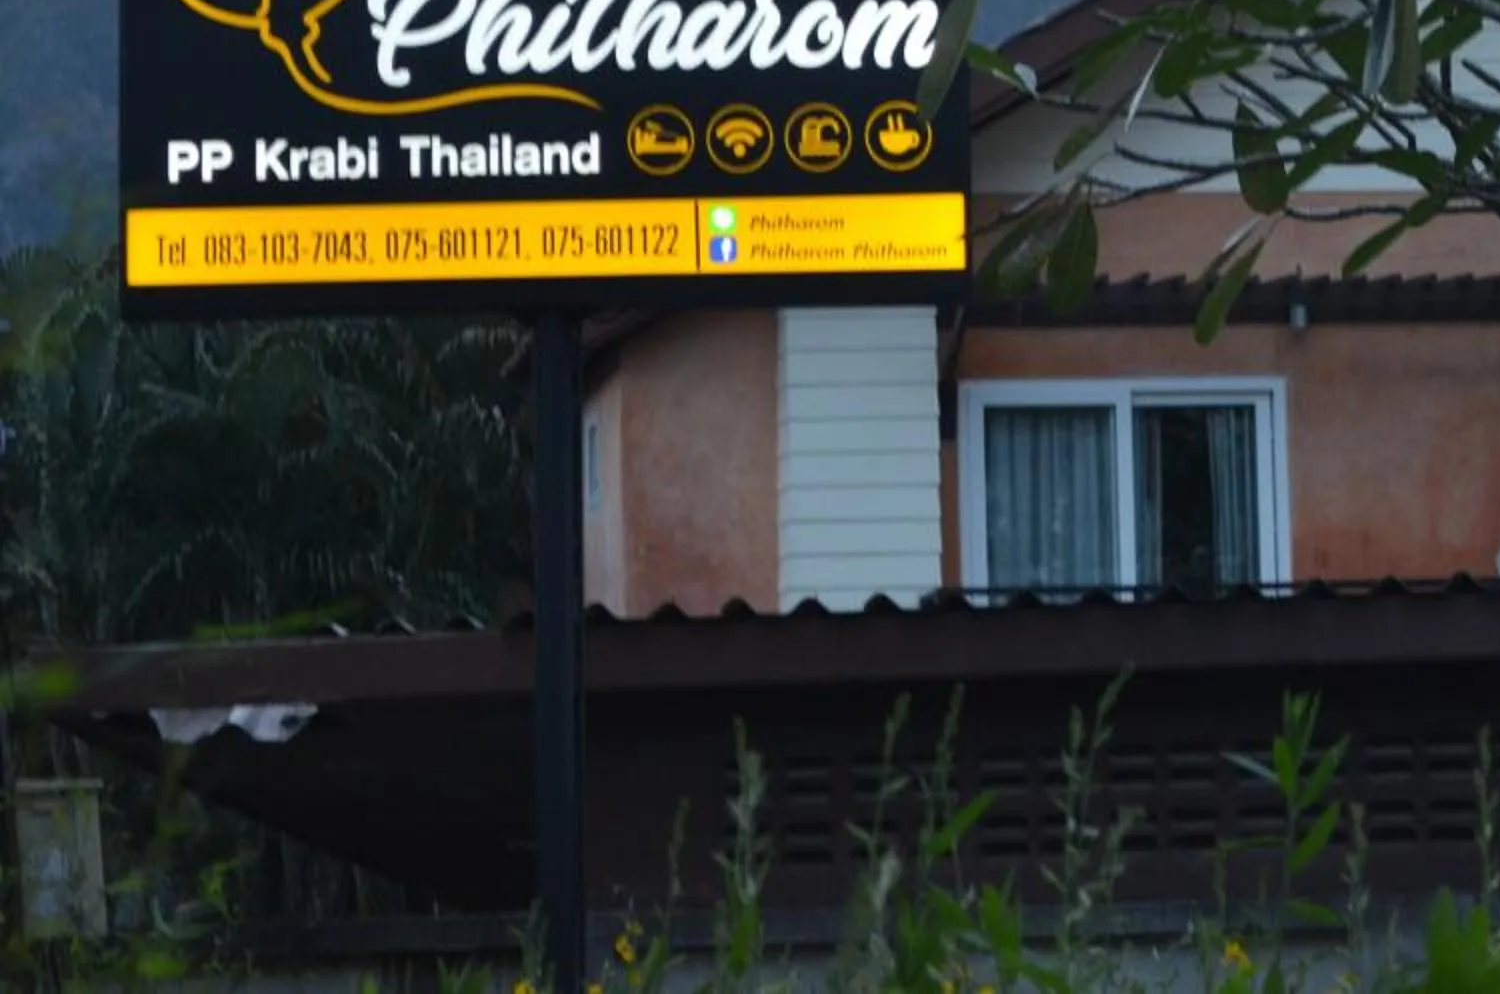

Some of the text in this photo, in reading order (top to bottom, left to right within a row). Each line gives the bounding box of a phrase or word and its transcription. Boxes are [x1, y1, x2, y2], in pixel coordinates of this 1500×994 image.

[167, 131, 601, 184] PP Krabi Thailand
[542, 223, 680, 257] 075-601122
